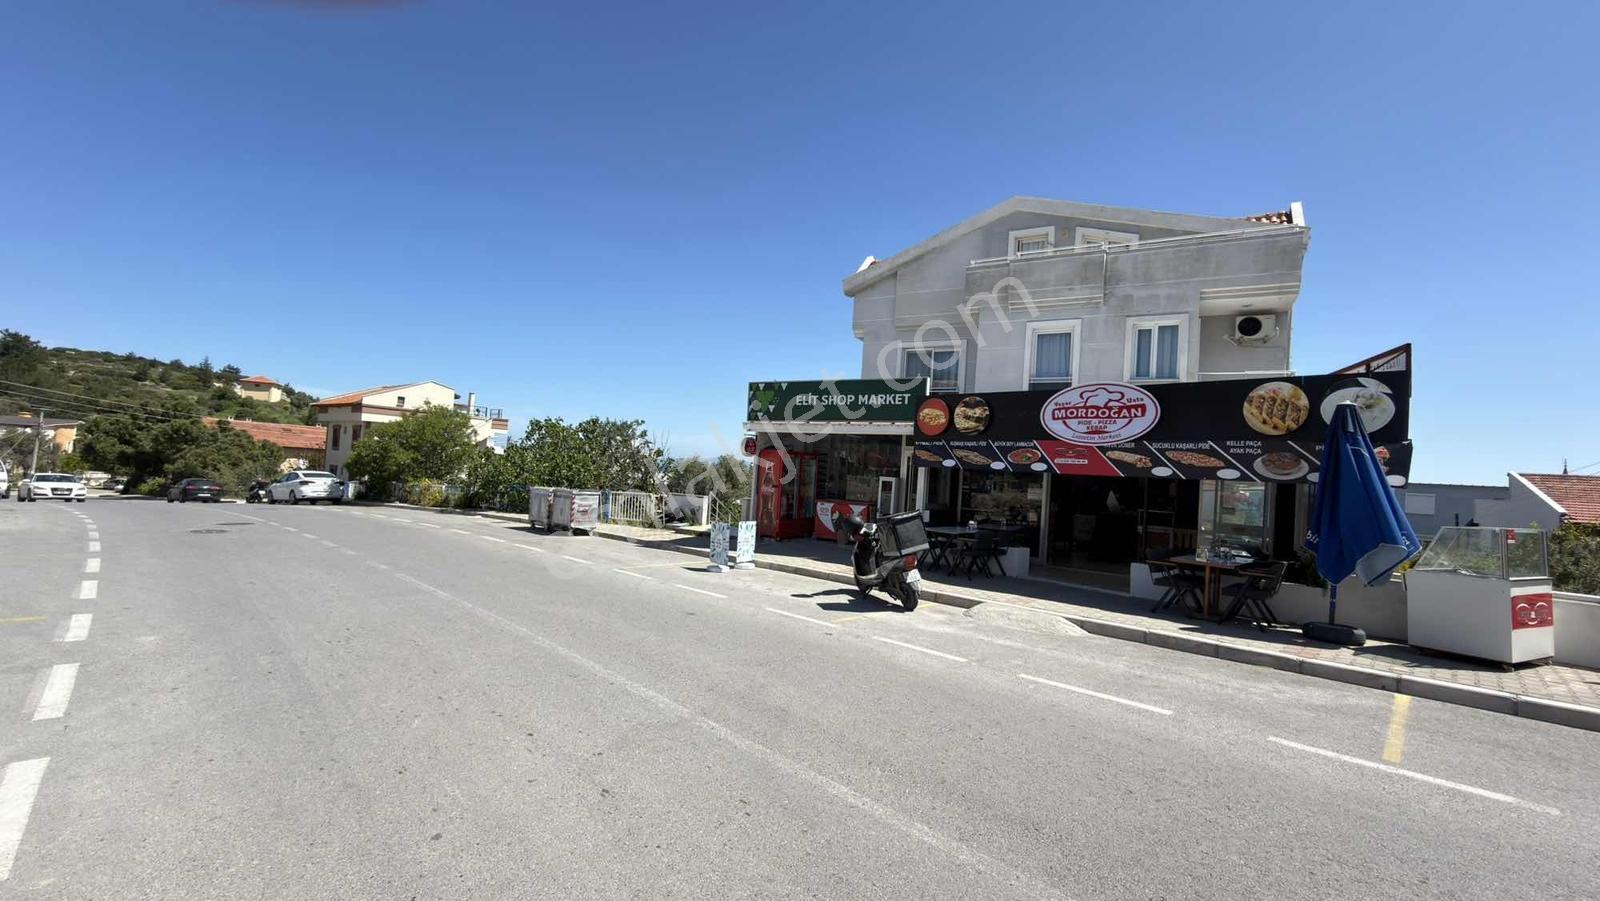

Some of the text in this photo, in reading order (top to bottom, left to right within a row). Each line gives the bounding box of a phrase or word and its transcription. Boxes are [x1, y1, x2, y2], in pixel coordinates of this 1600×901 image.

[796, 393, 911, 406] ELİT SHOP MARKET
[1054, 406, 1142, 419] MORDOĞAN
[1246, 440, 1261, 448] PAÇA
